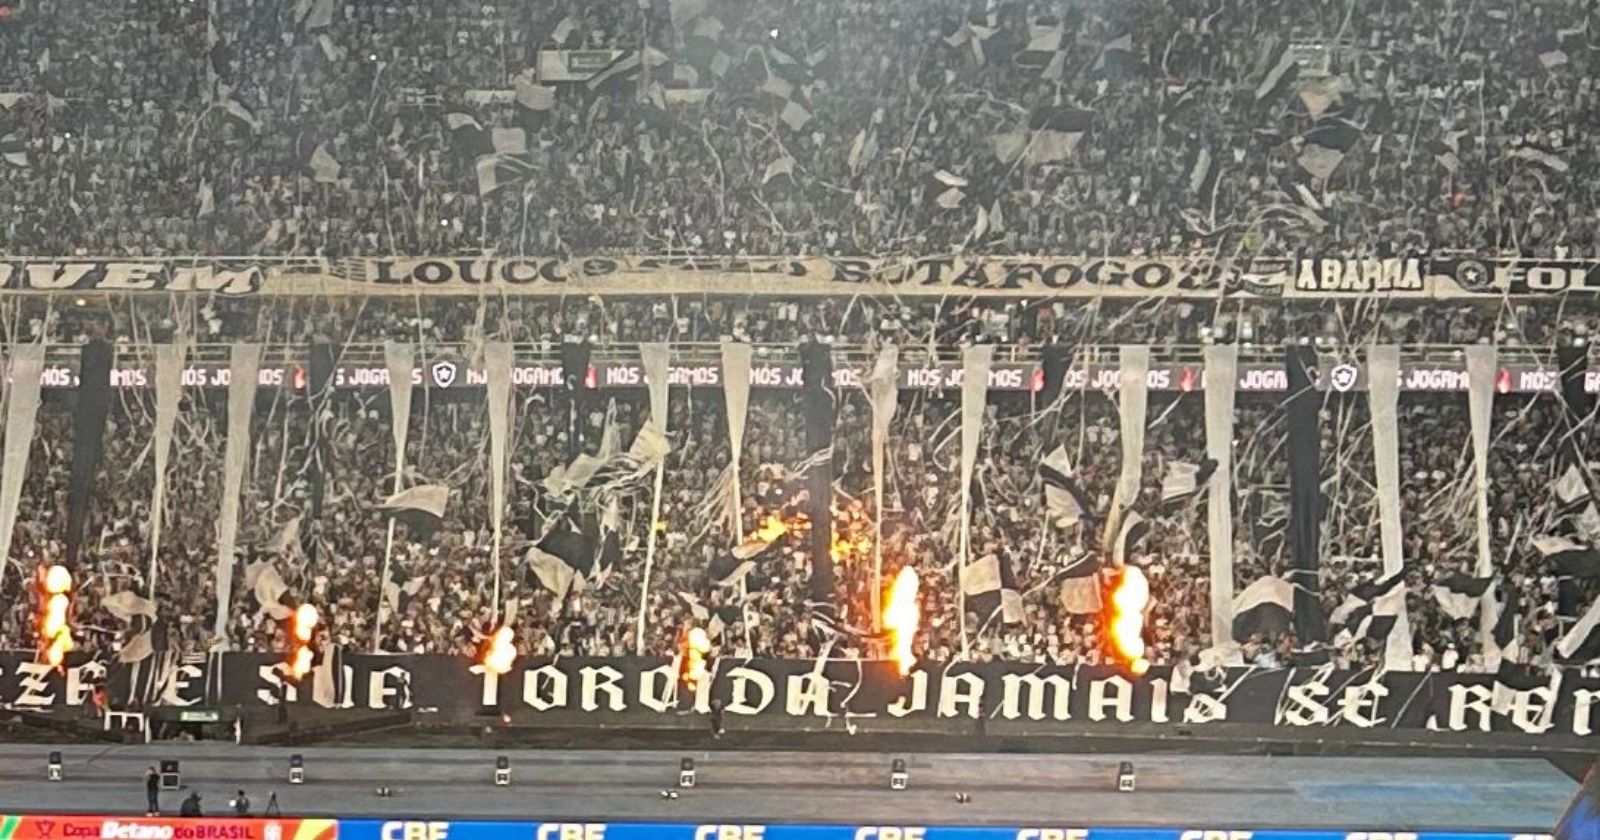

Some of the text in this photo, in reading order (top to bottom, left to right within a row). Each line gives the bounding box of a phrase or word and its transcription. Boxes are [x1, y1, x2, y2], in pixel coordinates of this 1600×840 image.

[0, 660, 108, 706] ZA
[1284, 681, 1390, 728] SE
[63, 820, 253, 840] Copa Betano do BRASIL
